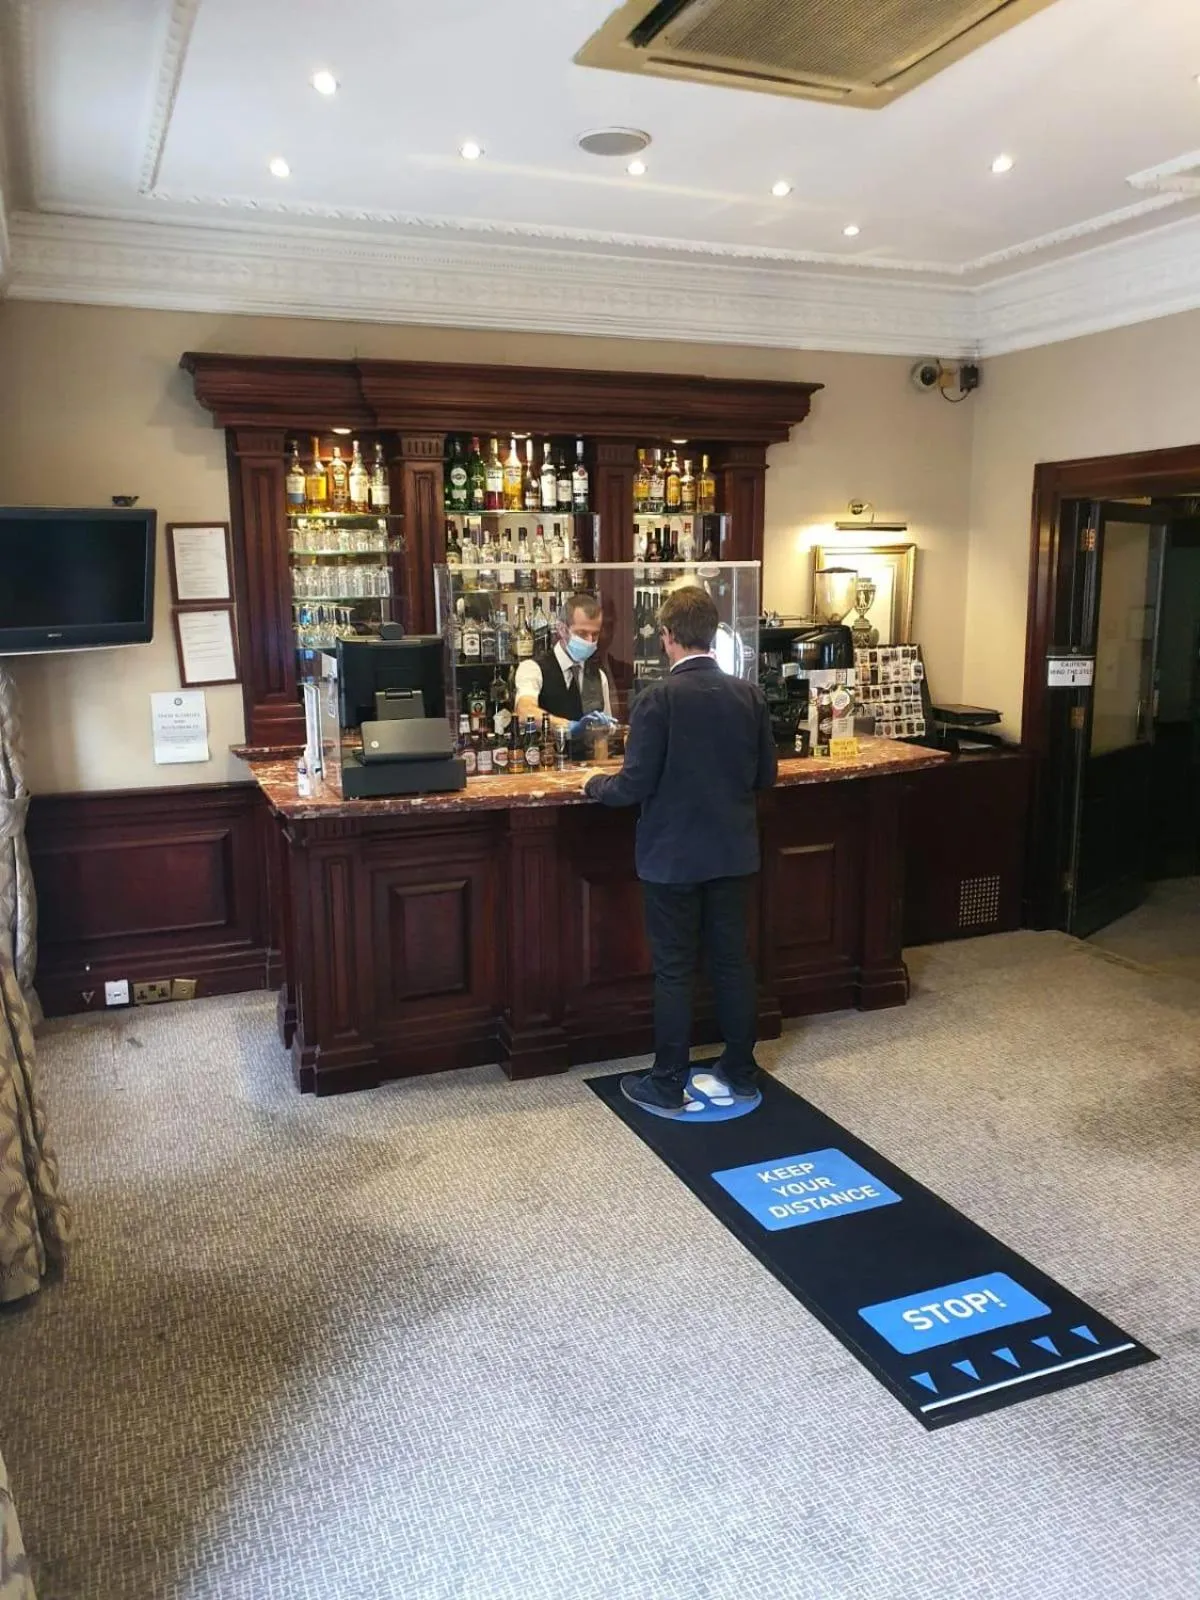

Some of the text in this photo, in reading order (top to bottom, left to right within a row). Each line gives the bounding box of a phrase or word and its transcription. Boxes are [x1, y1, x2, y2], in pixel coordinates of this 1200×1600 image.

[757, 1162, 815, 1183] KEEP
[771, 1177, 837, 1198] YOUR
[768, 1185, 881, 1219] DISTANCE
[902, 1289, 1008, 1331] STOP!
